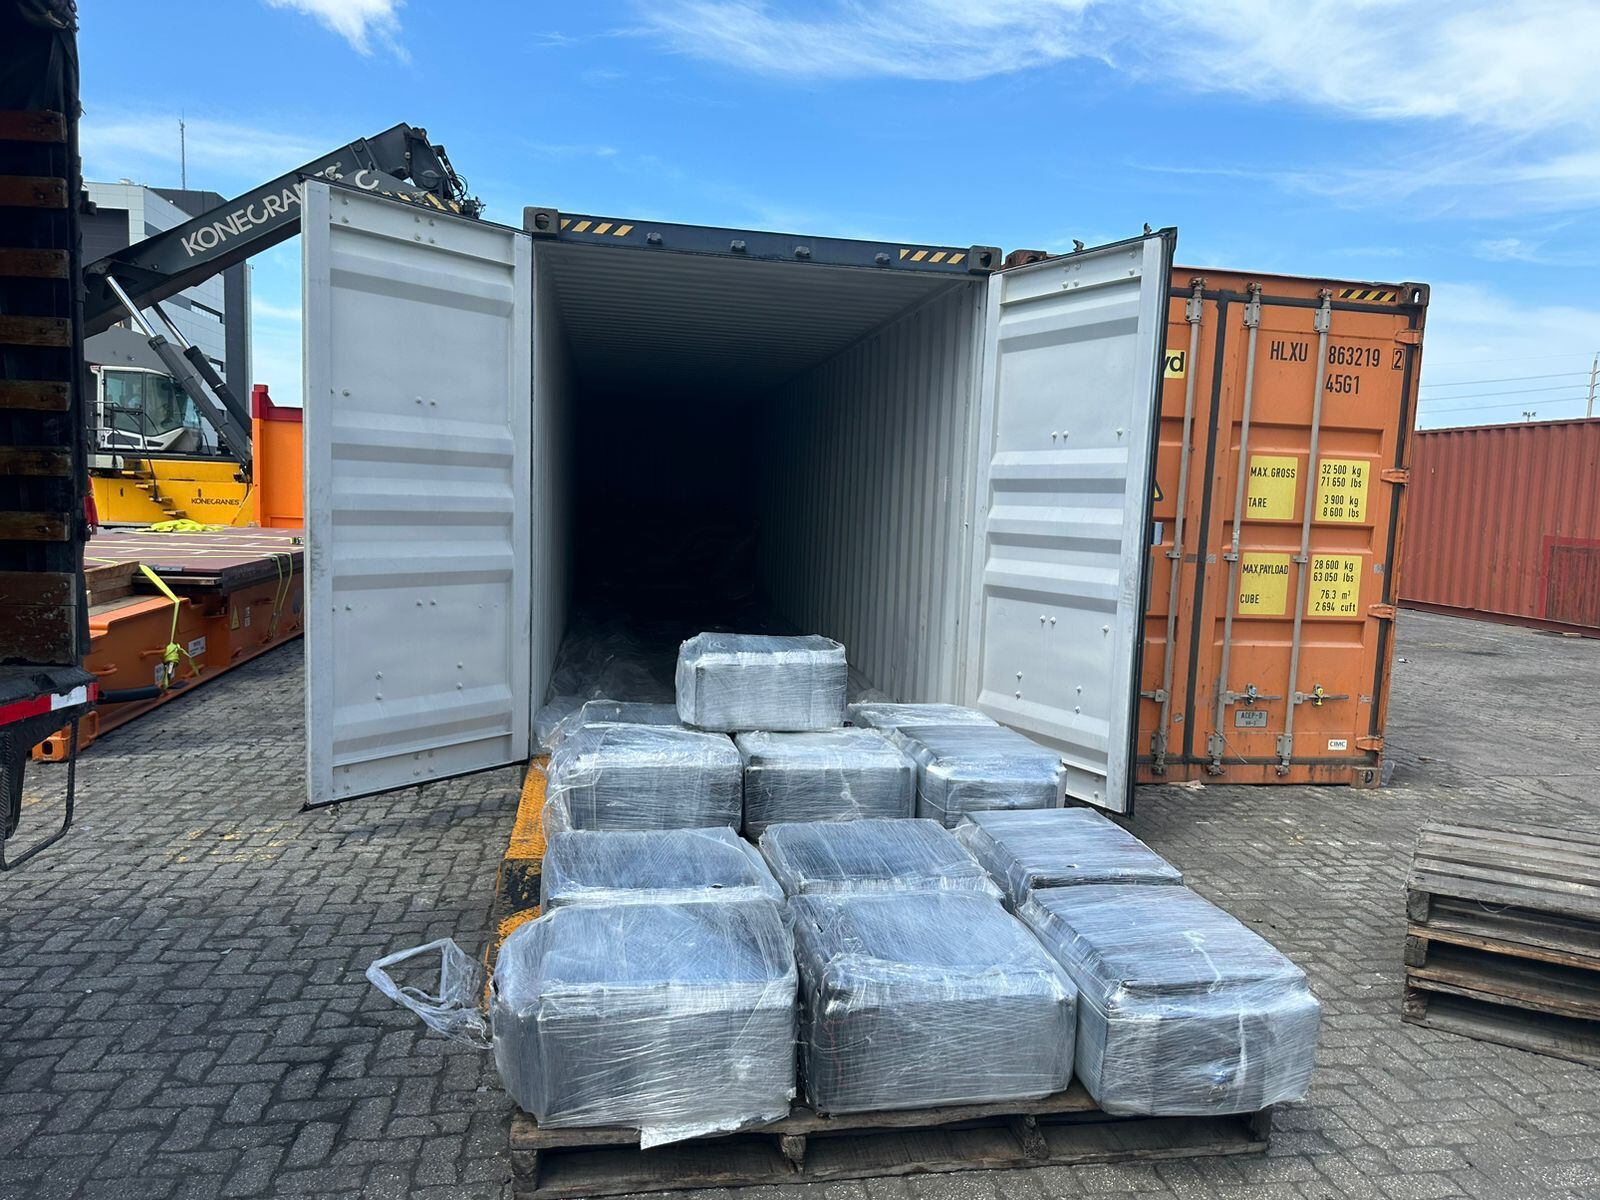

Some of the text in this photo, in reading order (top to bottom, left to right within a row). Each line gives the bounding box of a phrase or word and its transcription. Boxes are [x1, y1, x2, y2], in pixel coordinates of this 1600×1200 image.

[1270, 341, 1308, 362] HLXU
[1328, 345, 1380, 367] 863219
[1325, 374, 1360, 394] 45G1
[1271, 467, 1296, 478] GROSS
[1322, 464, 1362, 478] 32 500 kg
[1321, 476, 1362, 488] 71 650 lbs
[1248, 497, 1267, 508] TARE
[1324, 494, 1359, 508] 3 900 kg
[1322, 507, 1360, 518] 8 600 lbs
[1259, 564, 1289, 575] PAYLOAD
[1314, 559, 1354, 573] 28 600 kg
[1313, 572, 1354, 583] 63 050 lbs
[1240, 593, 1260, 604] CUBE
[1315, 601, 1356, 613] 2 694 cuft
